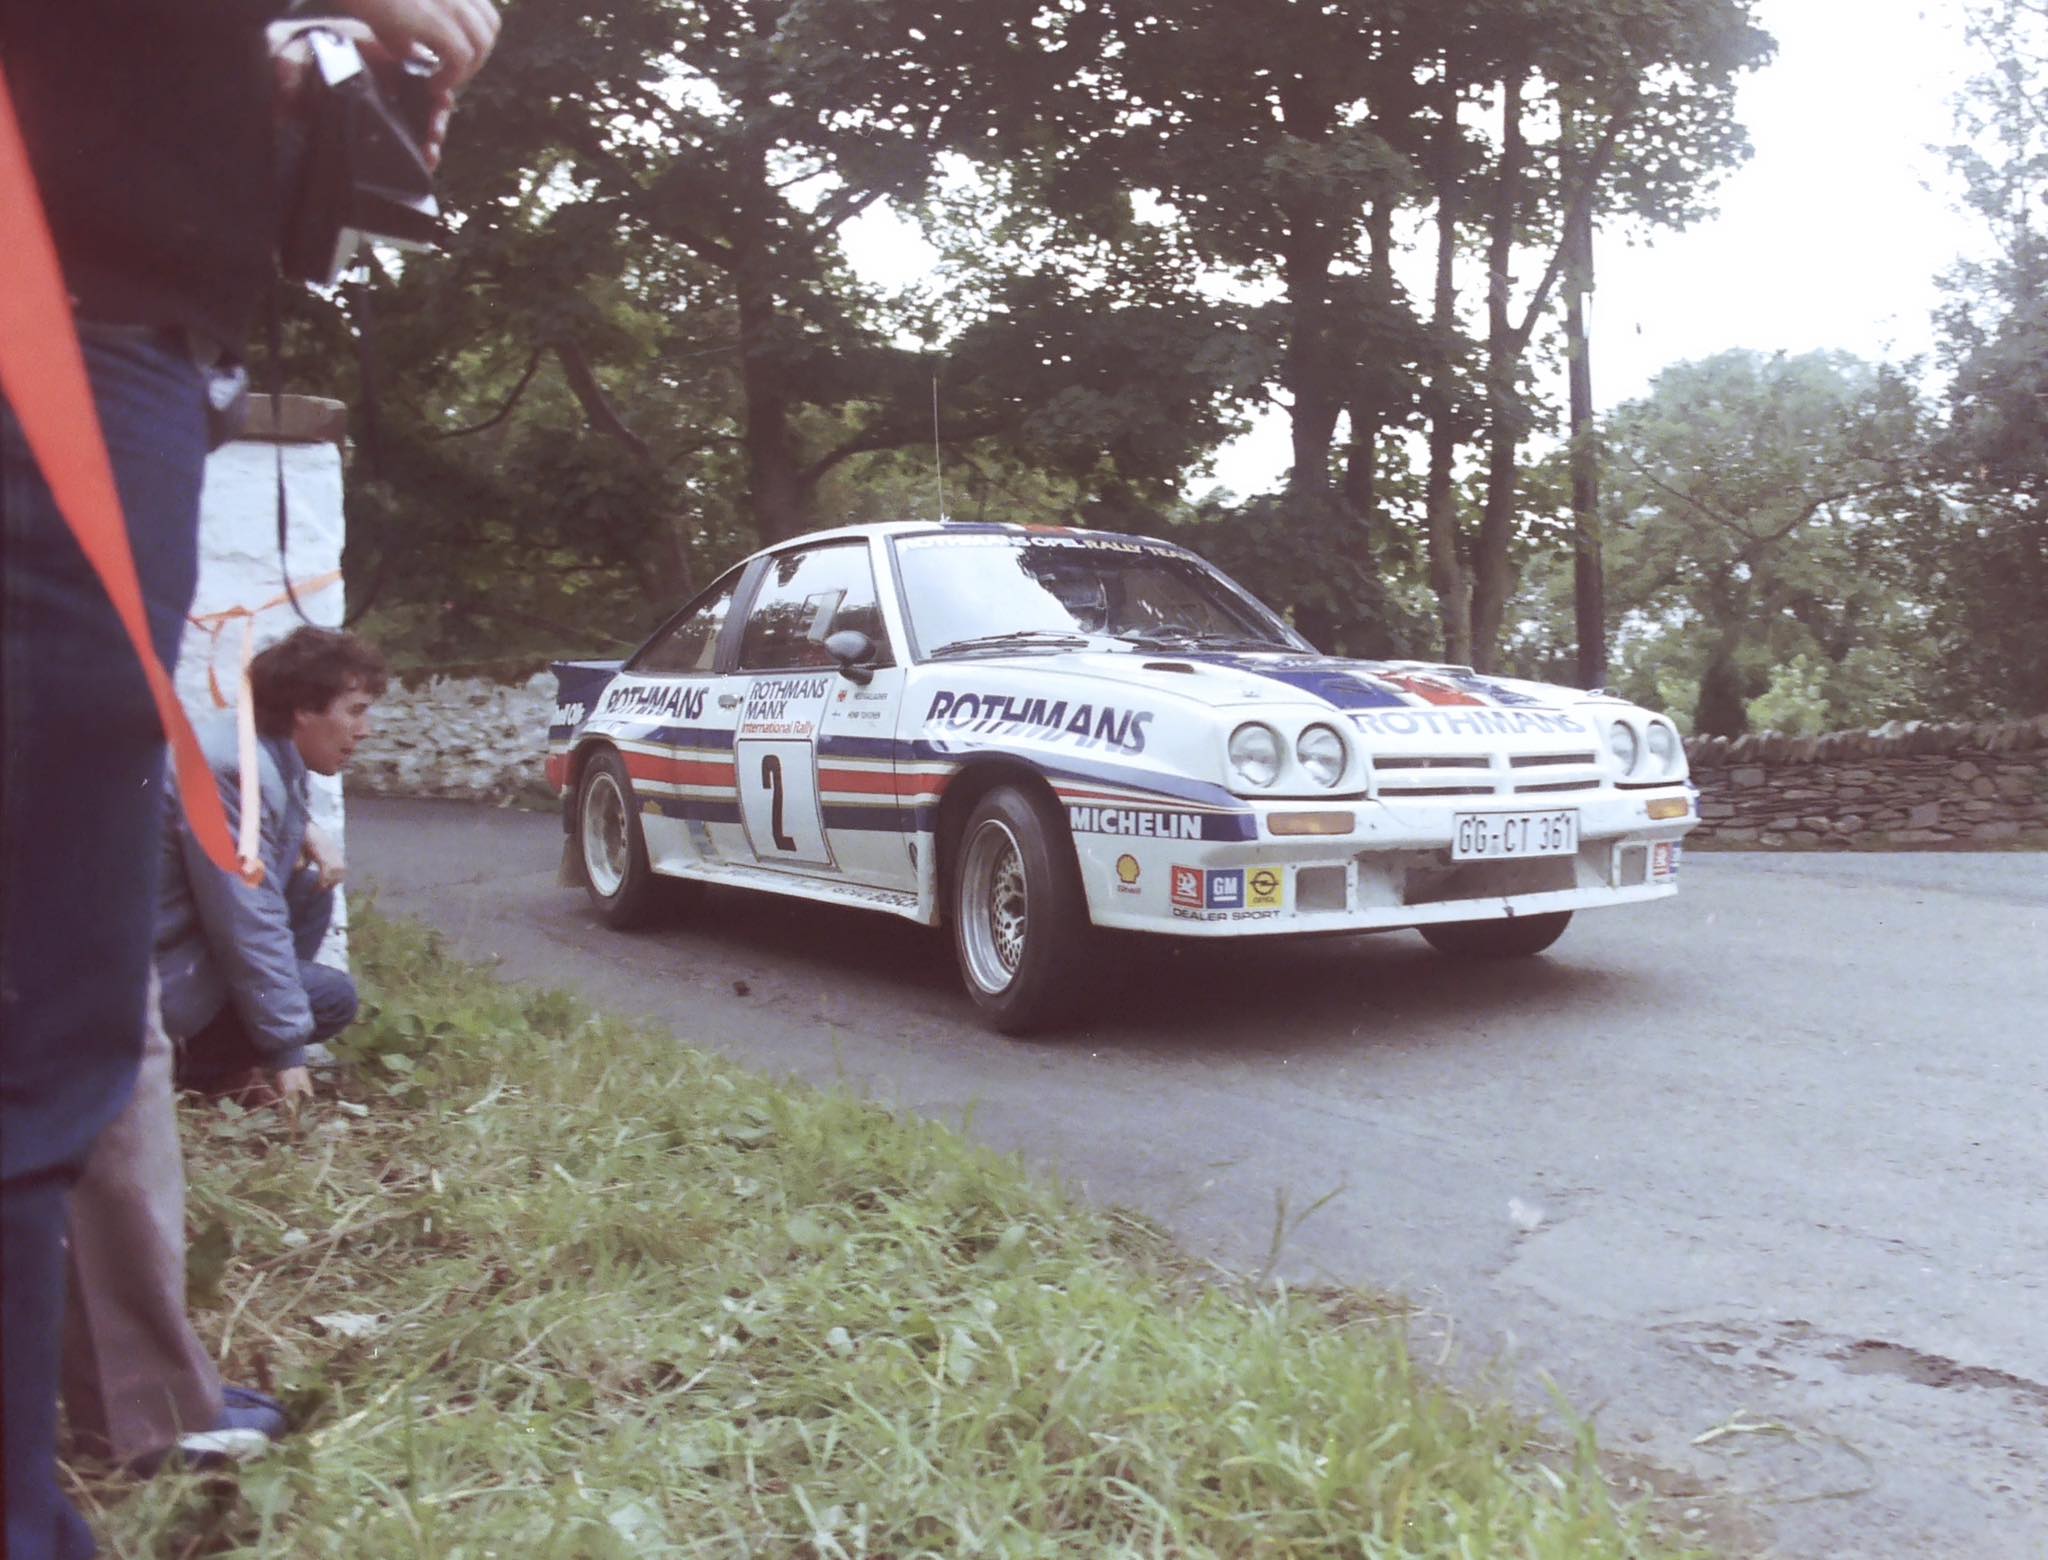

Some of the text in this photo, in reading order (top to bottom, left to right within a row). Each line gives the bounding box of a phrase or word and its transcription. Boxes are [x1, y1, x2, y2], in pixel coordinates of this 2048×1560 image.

[1084, 539, 1141, 553] RALLY
[751, 679, 828, 700] ROTHMANS
[607, 686, 709, 720] ROTHMANS
[746, 701, 788, 720] MANX
[793, 720, 815, 737] Rally
[924, 691, 1154, 756] ROTHMANS
[1347, 711, 1586, 735] ROTHMANS
[762, 755, 797, 852] 2
[1070, 806, 1202, 839] MICHELIN
[1460, 816, 1571, 853] GG-CT 361
[1213, 877, 1238, 897] GM
[1173, 907, 1280, 921] DEALER SPORT
